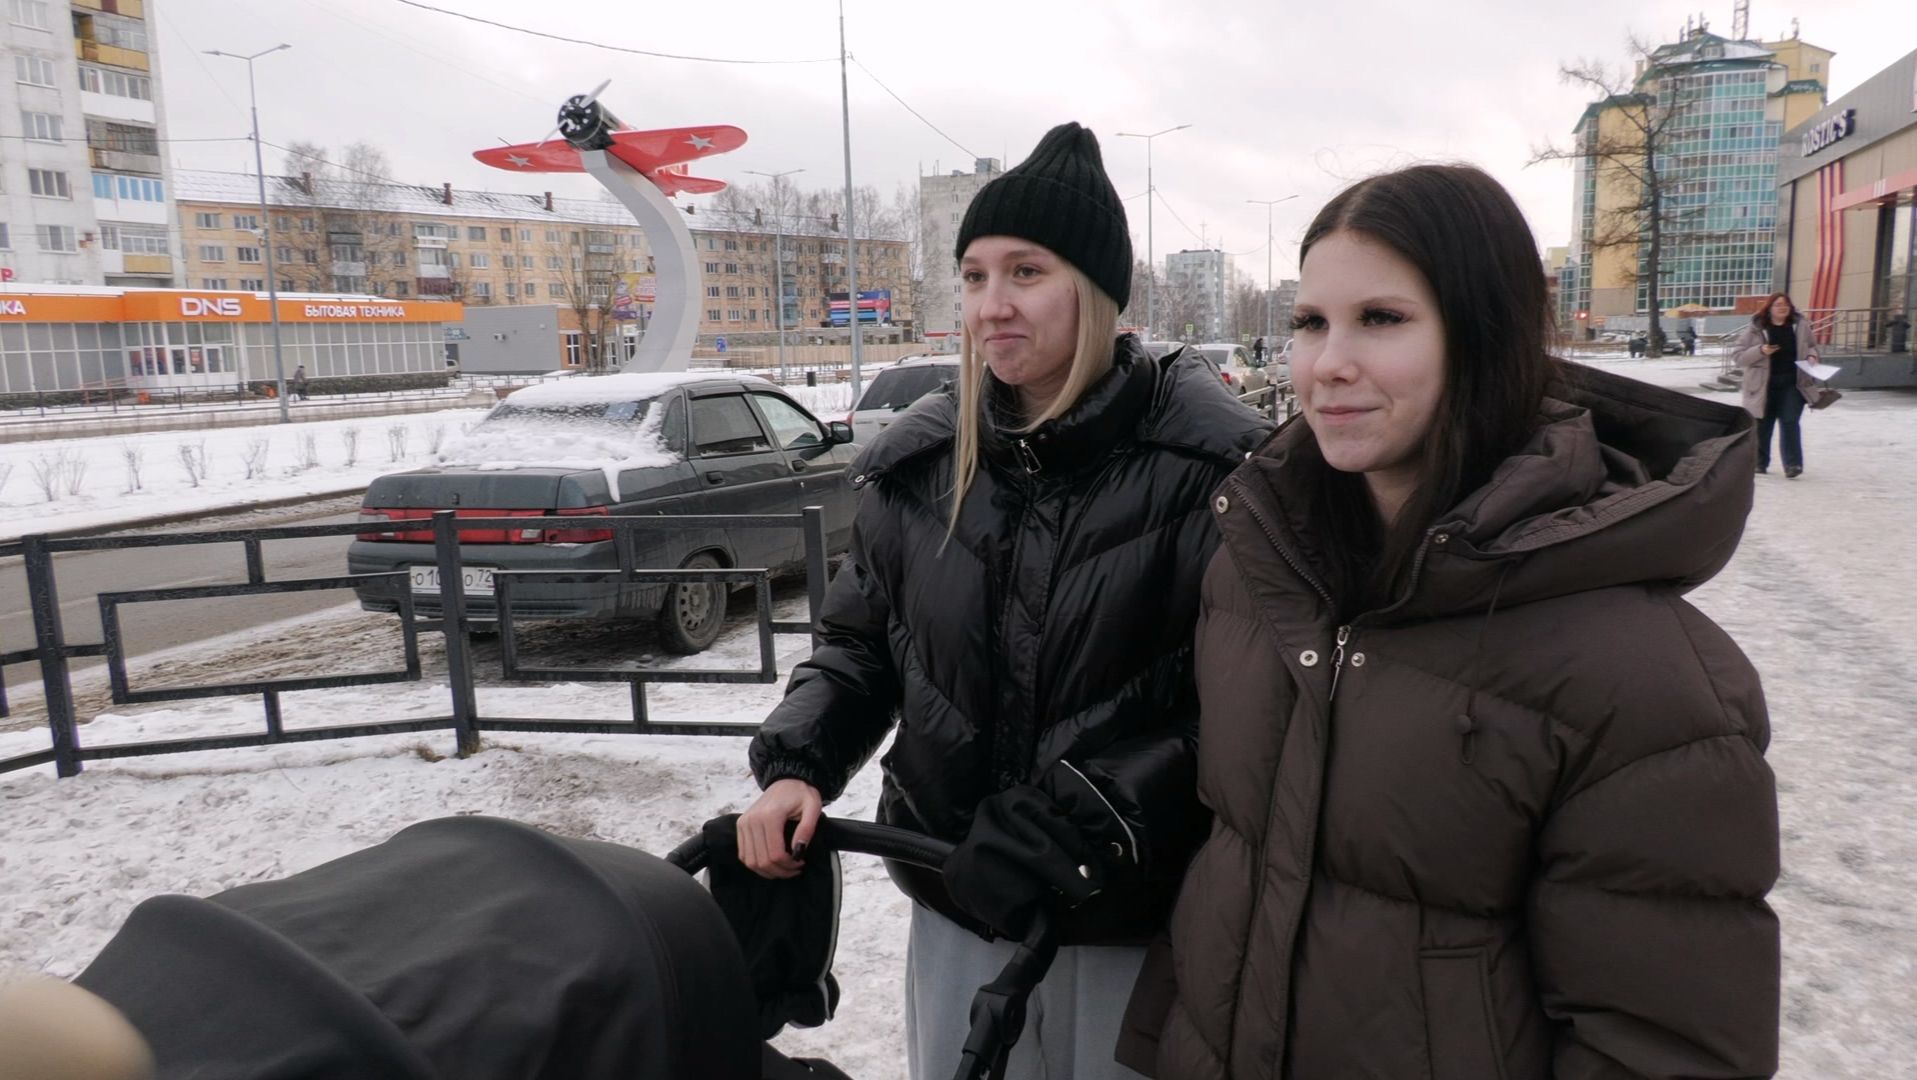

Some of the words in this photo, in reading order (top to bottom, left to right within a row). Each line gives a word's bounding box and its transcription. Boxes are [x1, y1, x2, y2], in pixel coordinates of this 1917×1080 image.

[181, 298, 242, 316] DNS
[305, 305, 357, 317] БЫТОВАЯ
[358, 305, 405, 317] ТЕХНИКА
